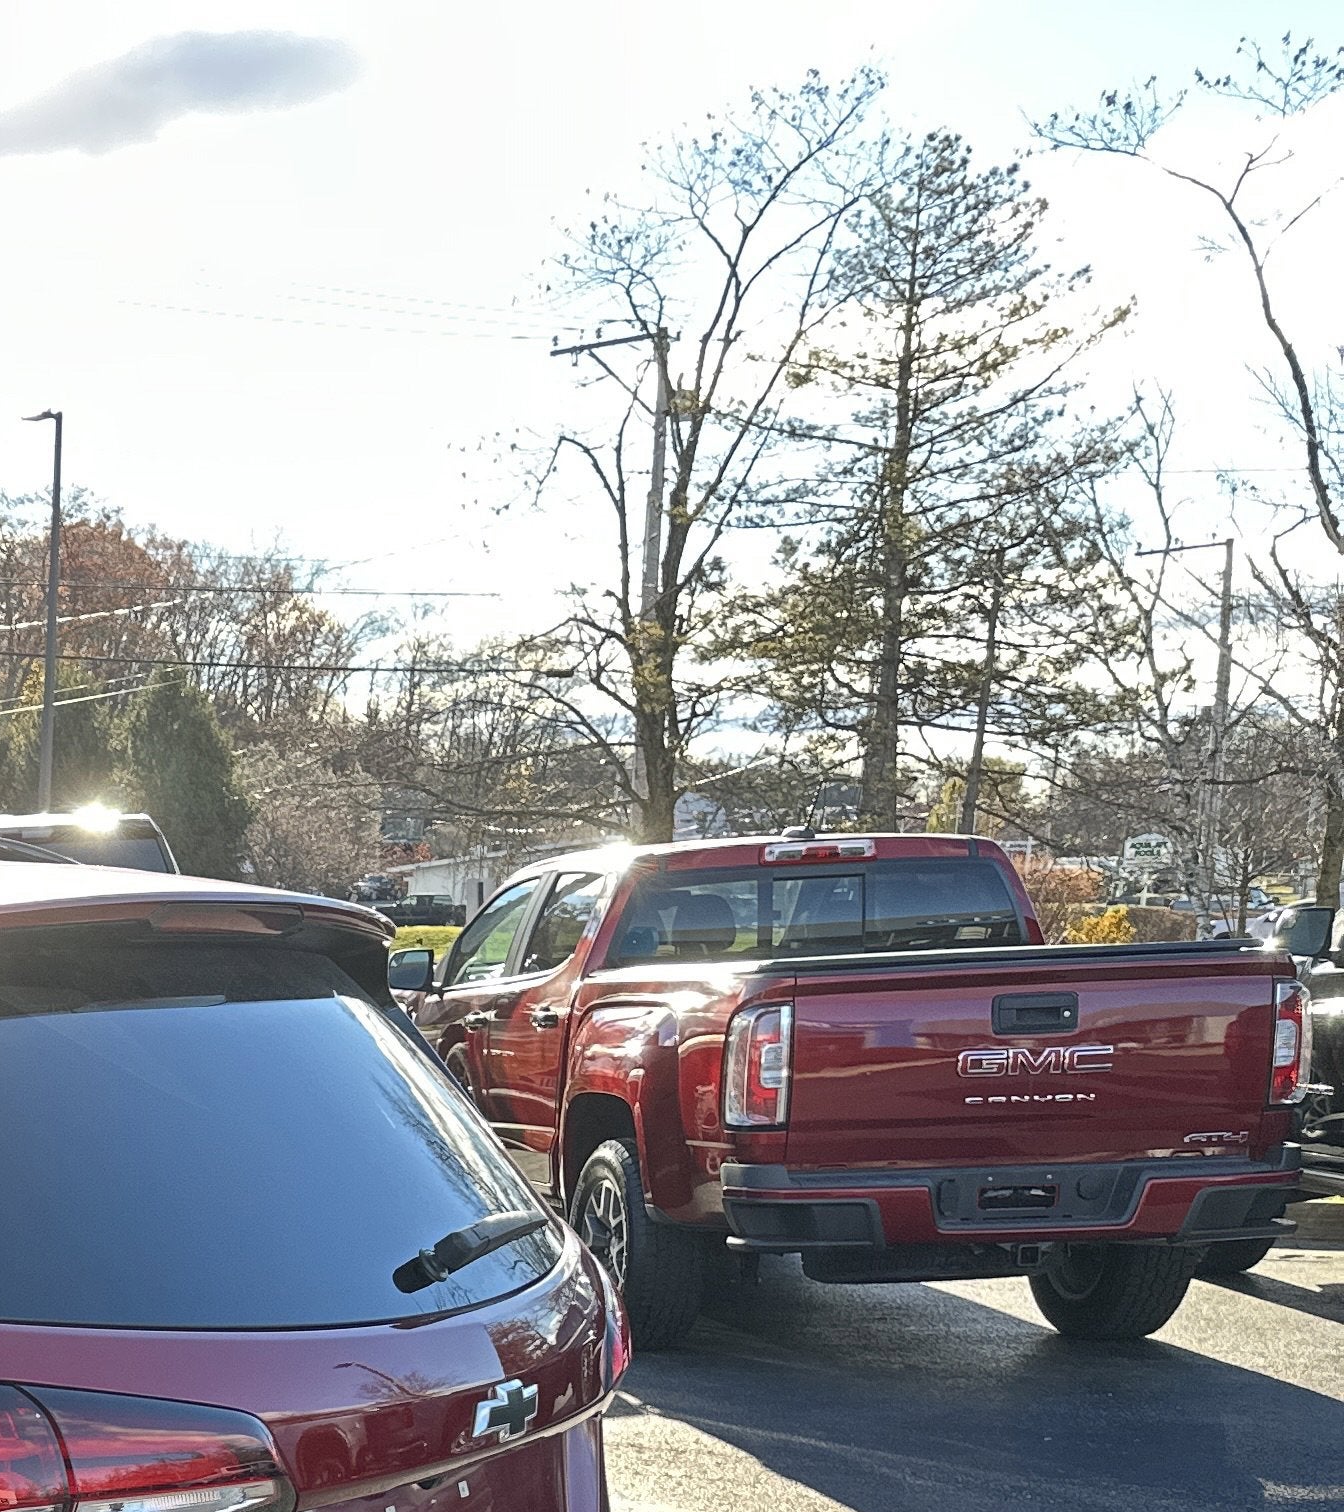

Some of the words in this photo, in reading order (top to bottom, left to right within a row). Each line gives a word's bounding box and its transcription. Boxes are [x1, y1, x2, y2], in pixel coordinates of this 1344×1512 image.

[957, 1045, 1114, 1077] GMC
[965, 1093, 1096, 1105] CANYON
[1183, 1131, 1249, 1143] AT4
